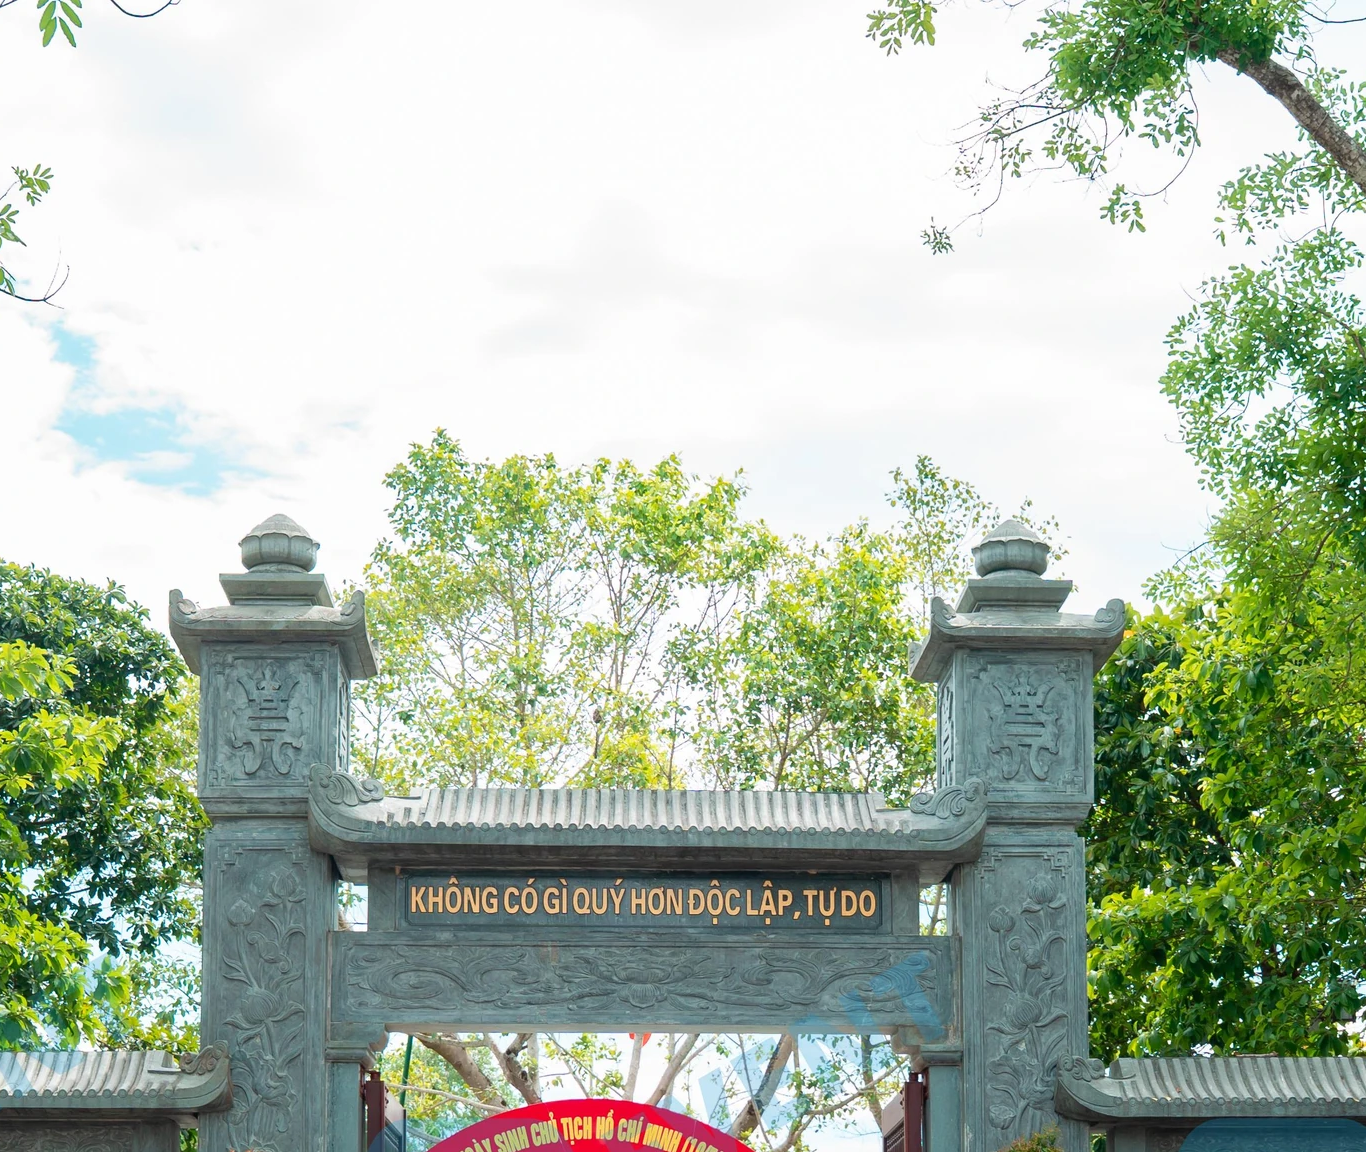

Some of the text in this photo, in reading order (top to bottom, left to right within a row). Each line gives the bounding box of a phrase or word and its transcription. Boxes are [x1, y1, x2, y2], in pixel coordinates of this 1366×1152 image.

[410, 875, 876, 926] KHÔNG CÓ GÌ QUÝ HƠN ĐỘC LẬP, TỰ DO
[530, 1111, 559, 1144] CHỦ
[560, 1115, 592, 1146] TỊCH
[596, 1109, 614, 1140] HỒ
[617, 1116, 645, 1144] CHÍ
